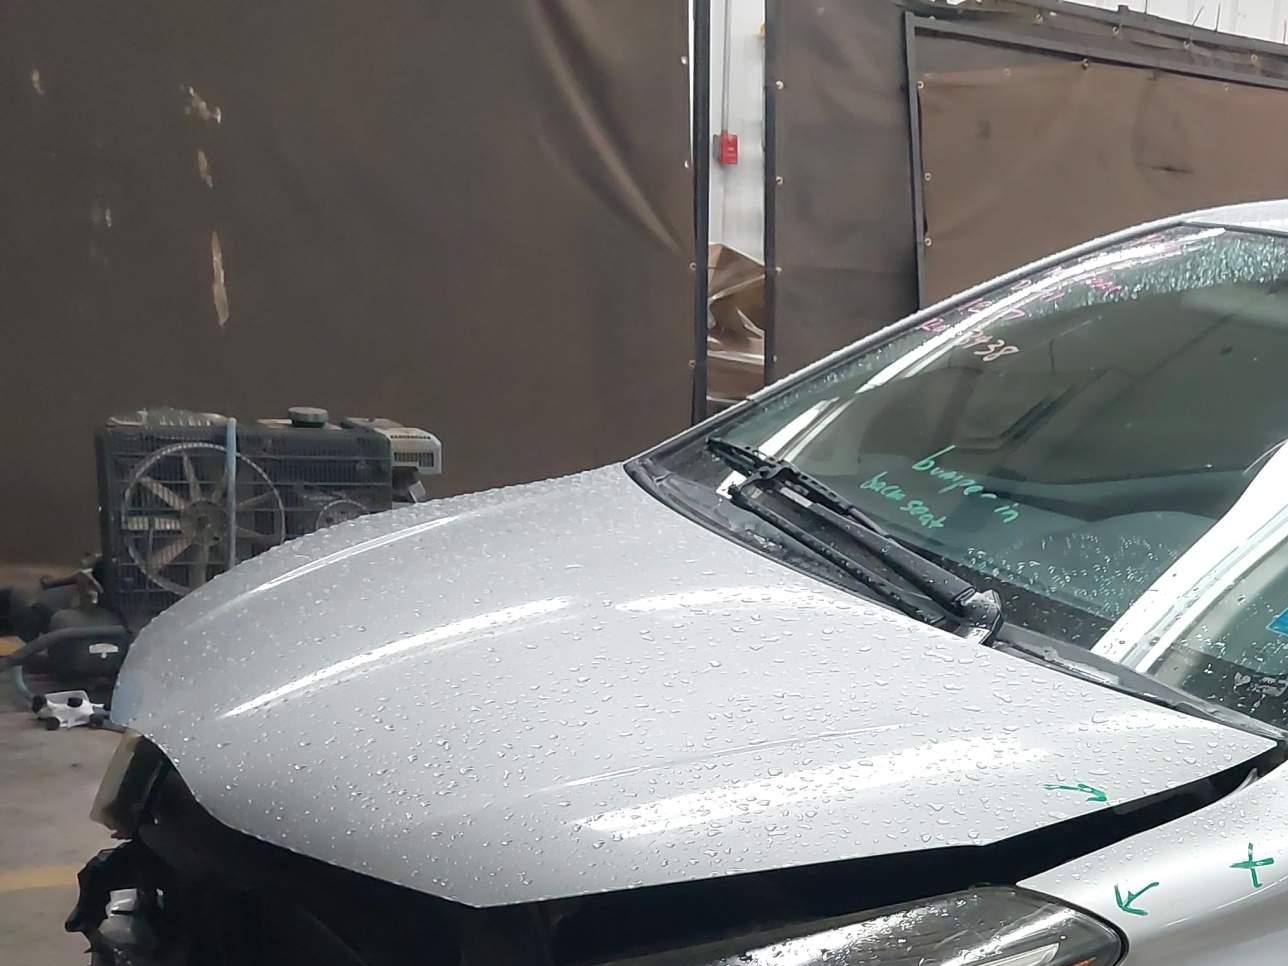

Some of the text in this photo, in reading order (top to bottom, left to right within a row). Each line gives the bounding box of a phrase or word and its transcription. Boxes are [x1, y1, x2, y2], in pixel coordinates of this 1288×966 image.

[912, 444, 1019, 524] bumper in
[900, 500, 946, 528] seat
